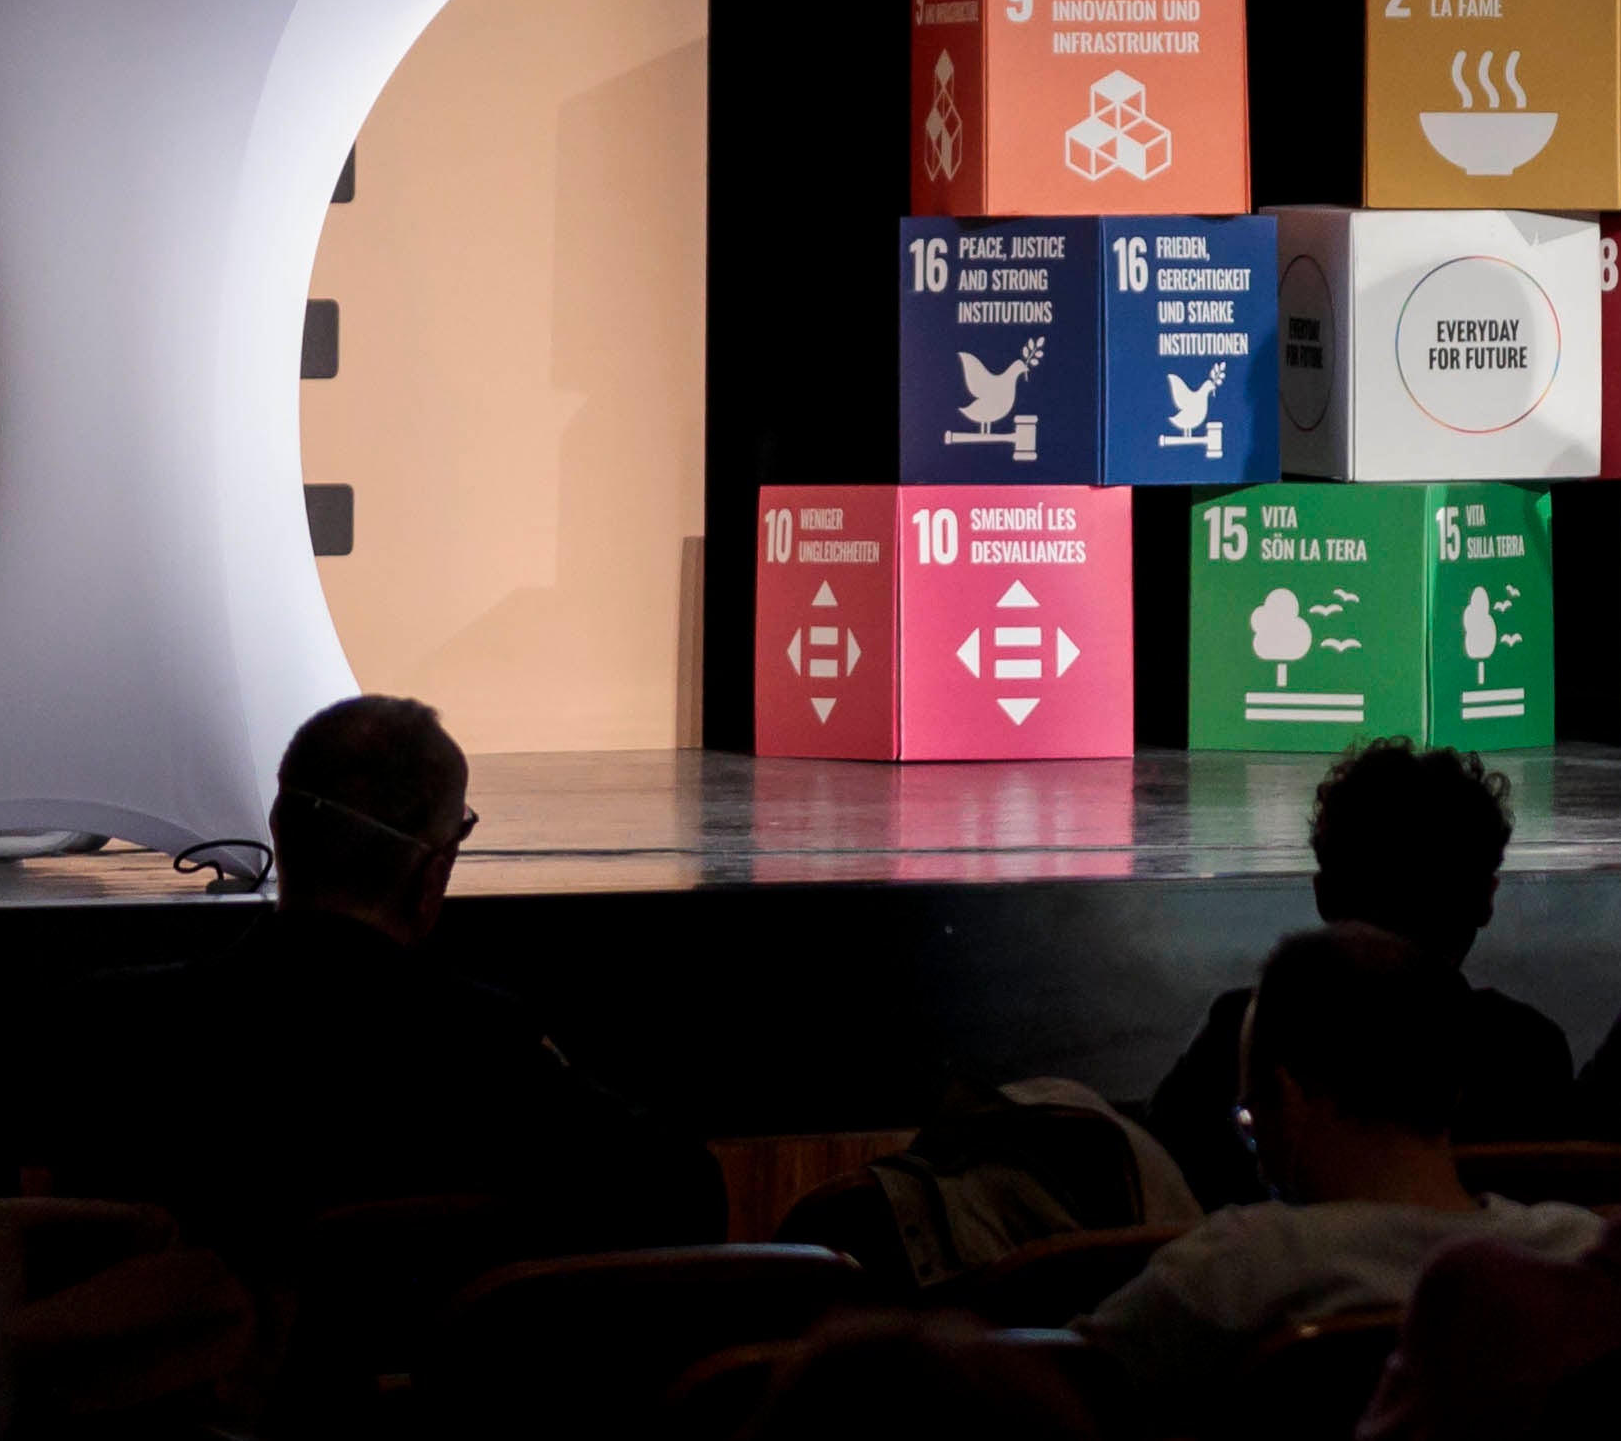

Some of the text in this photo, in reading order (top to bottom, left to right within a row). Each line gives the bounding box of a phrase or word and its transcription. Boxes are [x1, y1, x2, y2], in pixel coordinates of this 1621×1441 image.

[1052, 0, 1200, 22] INNOVATION UND
[1053, 31, 1200, 54] INFRASTRUKTUR
[959, 236, 1066, 261] PEACE, JUSTICE
[1156, 236, 1210, 261] FRIEDEN,
[909, 238, 948, 292] 16
[1112, 237, 1149, 292] 16
[1600, 238, 1619, 291] 8
[958, 269, 1048, 291] AND STRONG
[1157, 268, 1251, 291] GERECHTIGKEIT
[958, 301, 1052, 323] INSTITUTIONS
[1158, 300, 1235, 323] UND STARKE
[1437, 319, 1520, 342] EVERYDAY
[1158, 332, 1249, 356] INSTITUTIONEN
[1429, 346, 1528, 369] FOR FUTURE
[800, 508, 844, 530] WENIGER
[970, 502, 1076, 531] SMENDRÍ LES
[1261, 506, 1298, 528] VITA
[1466, 504, 1485, 527] VITA
[764, 508, 793, 563] 10
[912, 509, 958, 564] 10
[1203, 506, 1248, 561] 15
[1435, 506, 1460, 561] 15
[799, 540, 879, 563] UNGLEICHHEITEN
[971, 540, 1087, 564] DESVALIANZES
[1261, 533, 1367, 561] SÖN LA TERA
[1467, 534, 1524, 559] SULLA TERRA
